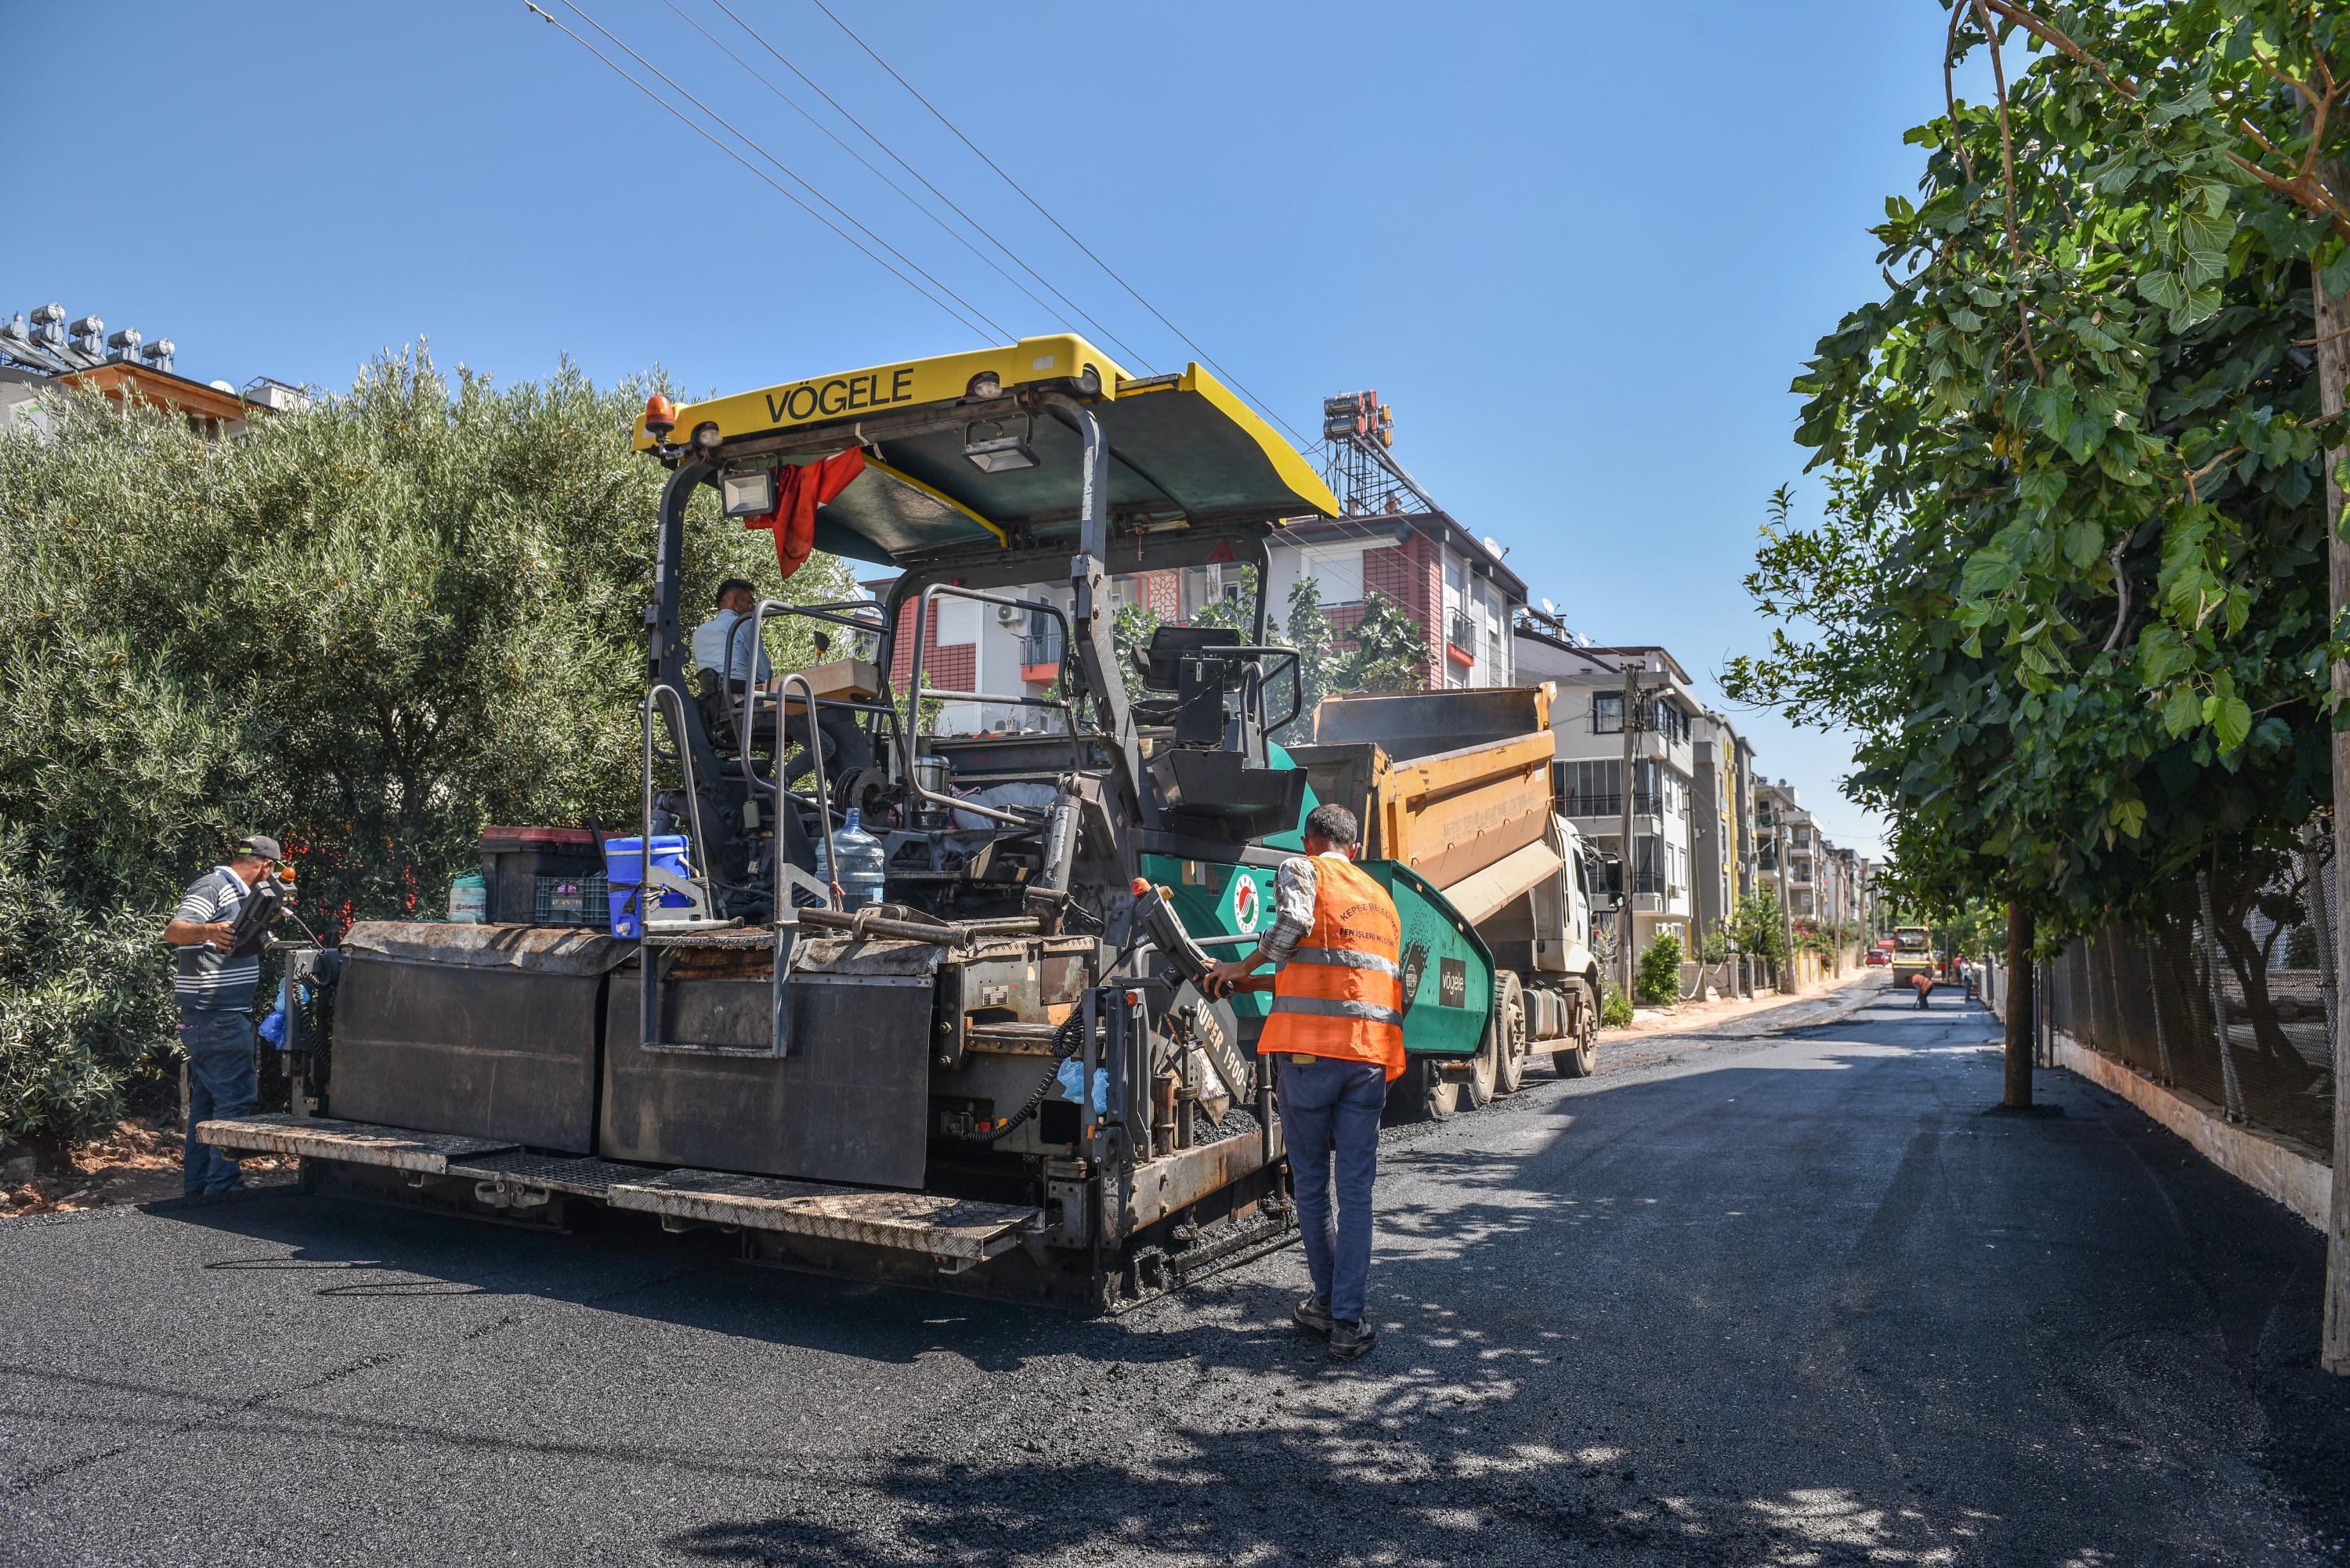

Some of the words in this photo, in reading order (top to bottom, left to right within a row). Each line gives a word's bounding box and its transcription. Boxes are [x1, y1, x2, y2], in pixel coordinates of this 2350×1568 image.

[765, 368, 913, 423] VÖGELE
[1235, 877, 1256, 897] KEPEZ
[1340, 903, 1368, 922] KEPEZ
[1340, 927, 1354, 936] FEN
[1356, 929, 1376, 941] İŞLERİ
[1442, 971, 1463, 995] vögele
[1196, 998, 1224, 1053] SUPER
